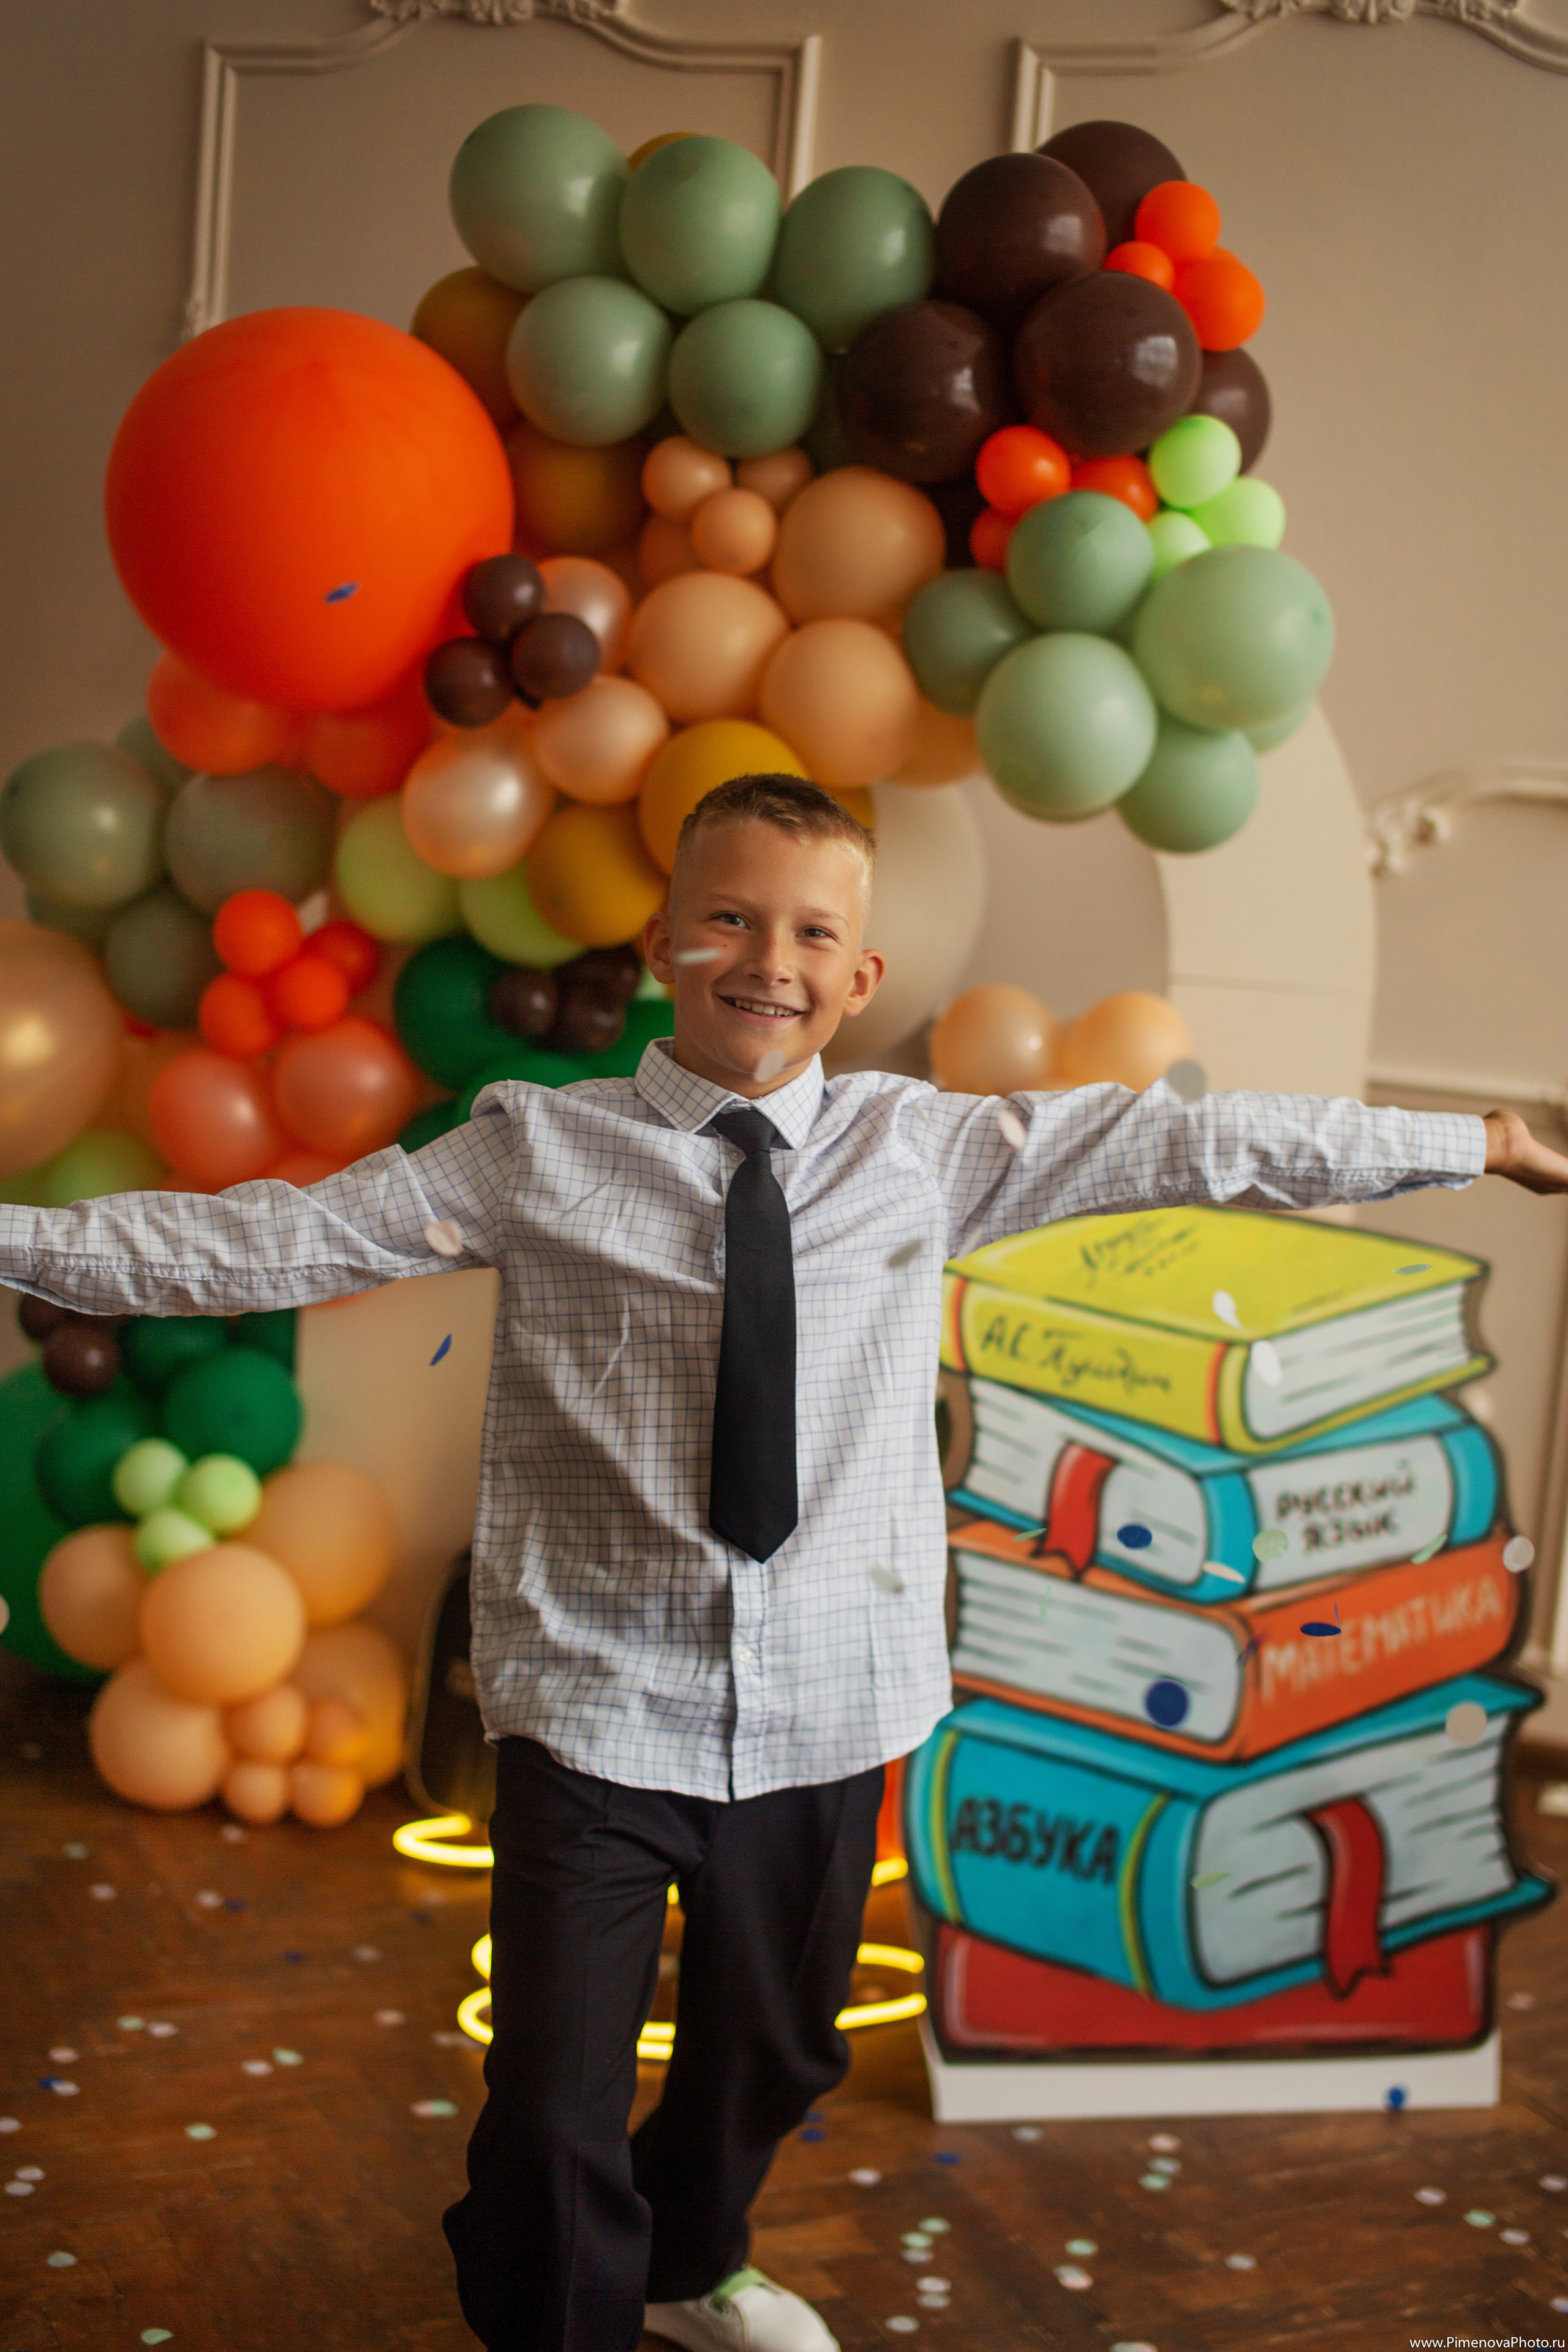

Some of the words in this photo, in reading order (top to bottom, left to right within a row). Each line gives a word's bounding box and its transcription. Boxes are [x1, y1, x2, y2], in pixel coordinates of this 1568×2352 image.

[1276, 1458, 1415, 1522] РУССКИЙ
[1303, 1509, 1400, 1551] ЯЗЫК
[1261, 1575, 1503, 1704] МАТЕМАТИКА
[951, 1795, 1120, 1885] АЗБУКА
